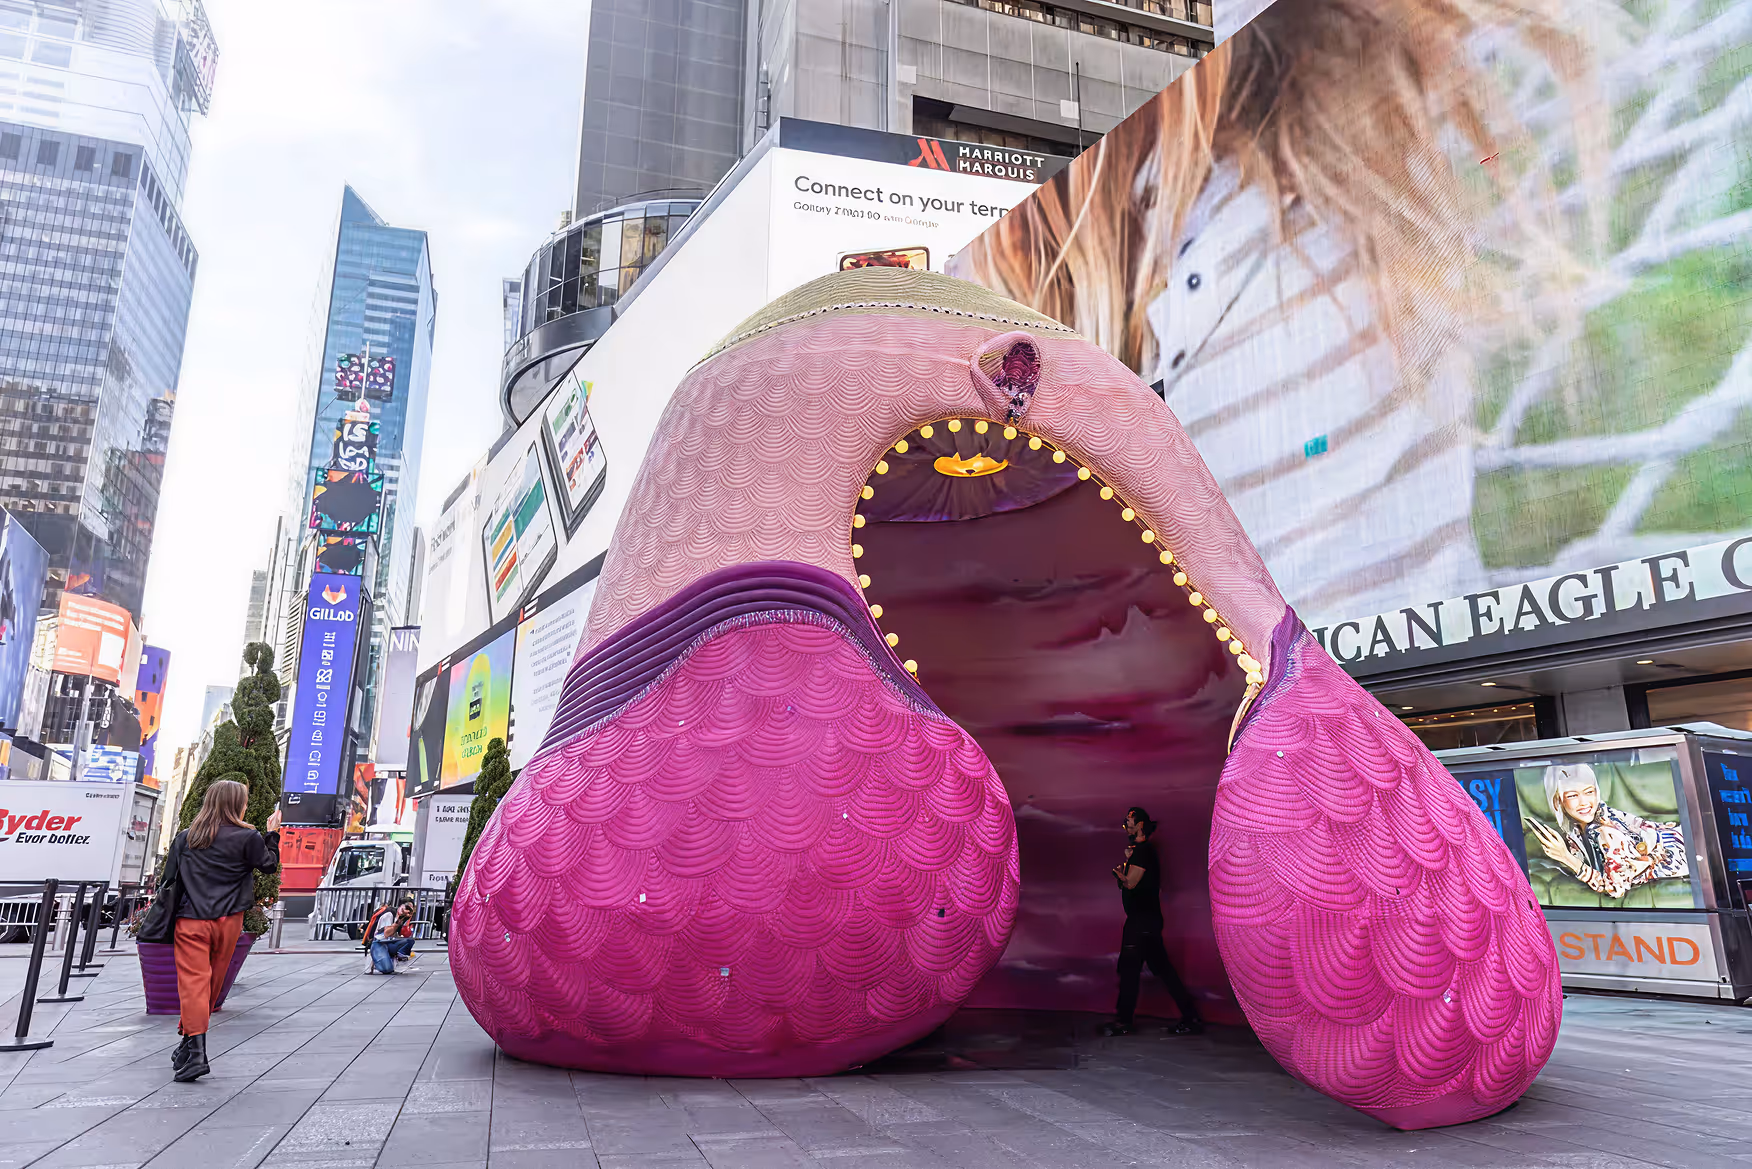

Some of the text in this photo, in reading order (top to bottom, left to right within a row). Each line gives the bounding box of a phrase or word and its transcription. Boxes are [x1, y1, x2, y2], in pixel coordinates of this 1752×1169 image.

[959, 146, 1045, 168] MARRIOTT
[959, 160, 1035, 180] MARQUIS
[794, 176, 884, 203] Connect
[889, 192, 914, 207] on
[918, 197, 965, 214] your
[1464, 550, 1697, 641] EAGLE
[1459, 778, 1501, 812] SY
[1559, 932, 1701, 966] STAND
